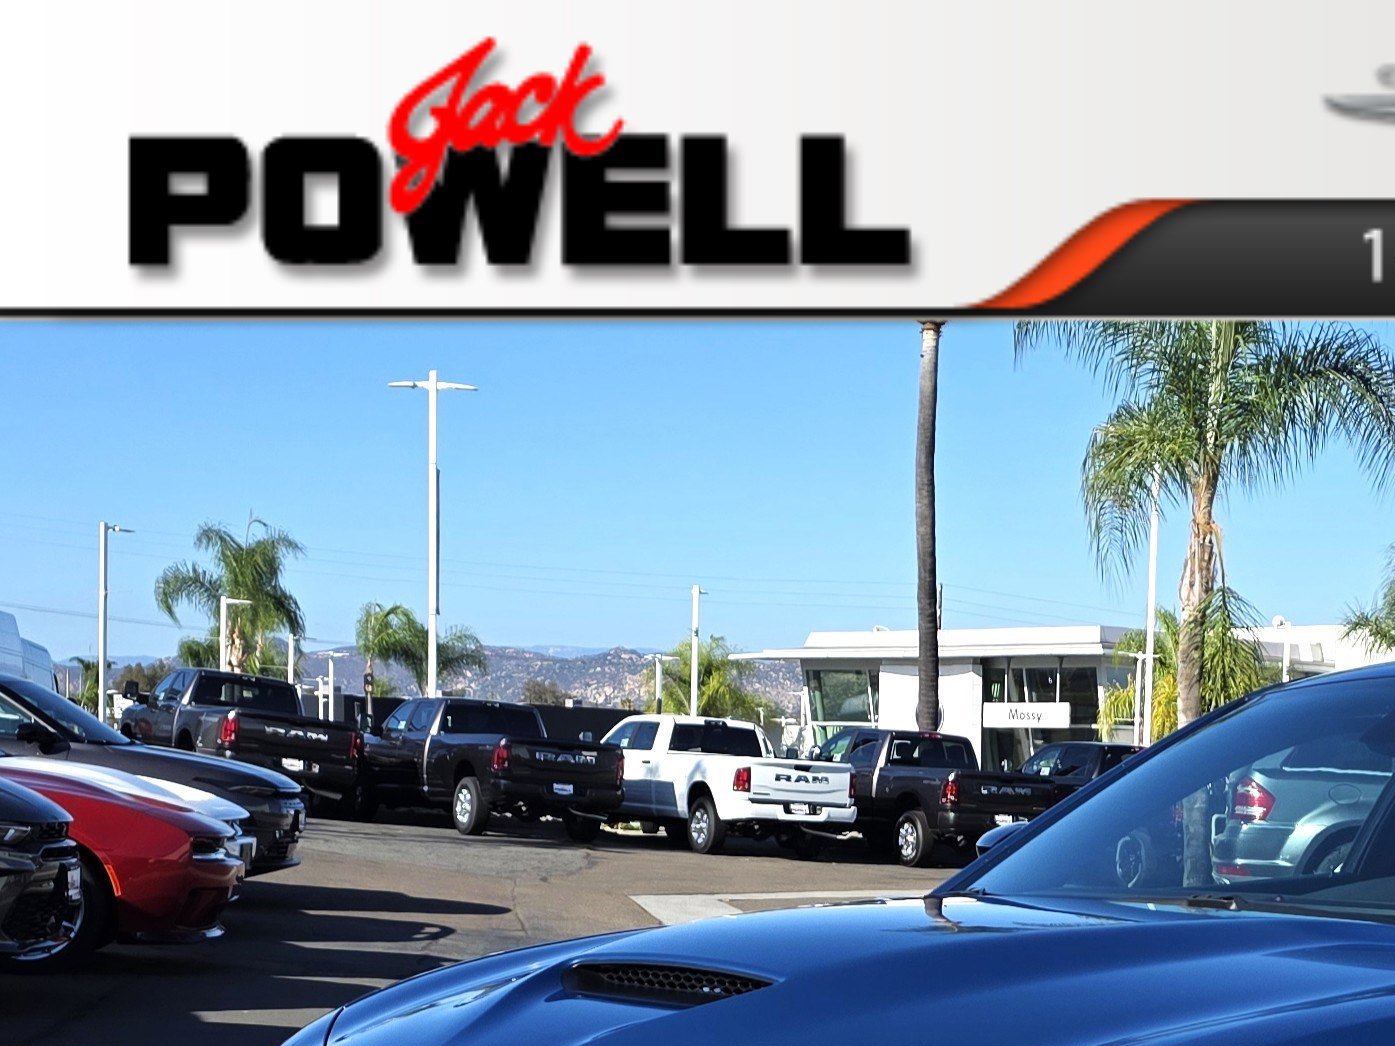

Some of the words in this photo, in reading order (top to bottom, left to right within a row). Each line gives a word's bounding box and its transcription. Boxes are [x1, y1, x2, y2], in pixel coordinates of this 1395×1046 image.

[1008, 708, 1042, 723] Mossy
[774, 773, 830, 785] RAM
[981, 785, 1032, 796] RAM
